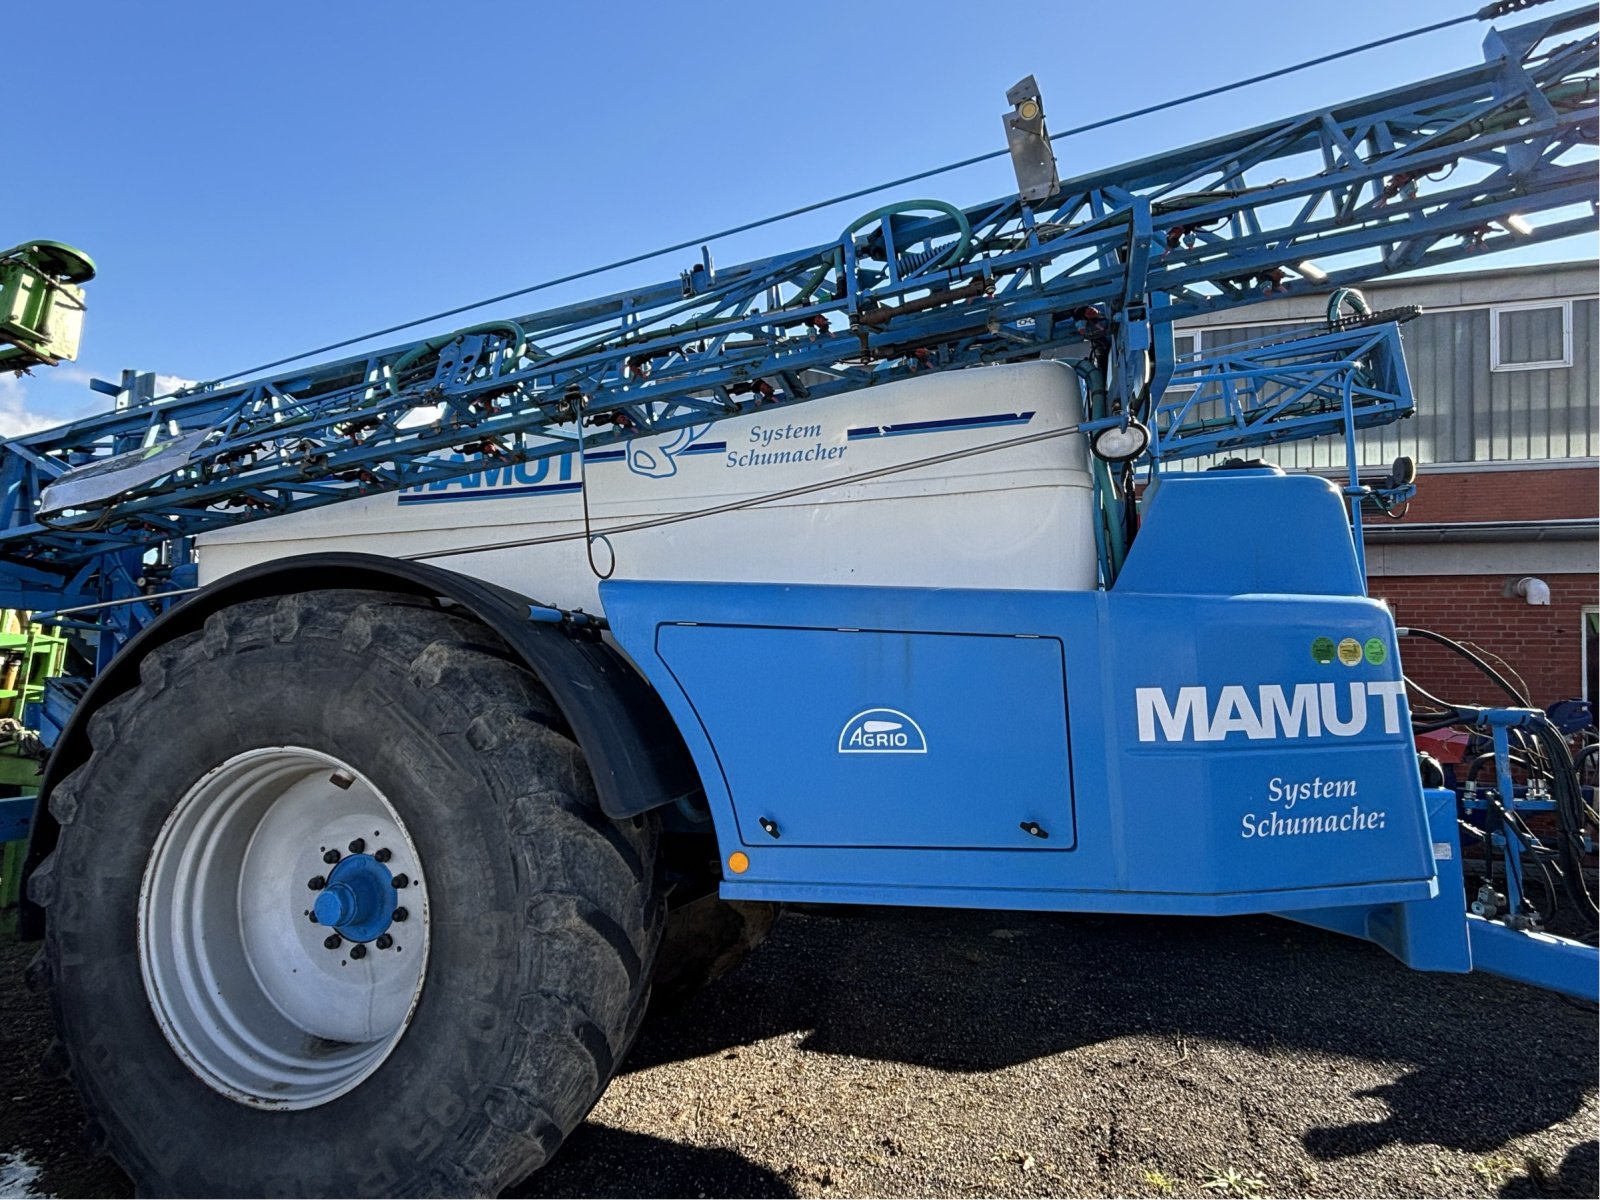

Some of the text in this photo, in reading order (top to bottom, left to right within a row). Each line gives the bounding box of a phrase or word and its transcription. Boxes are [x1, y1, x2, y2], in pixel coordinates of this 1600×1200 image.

[750, 423, 821, 447] System
[726, 442, 848, 468] Schumacher
[1135, 680, 1406, 742] MAMUT
[849, 726, 908, 747] AGRIO
[1268, 777, 1357, 809] System
